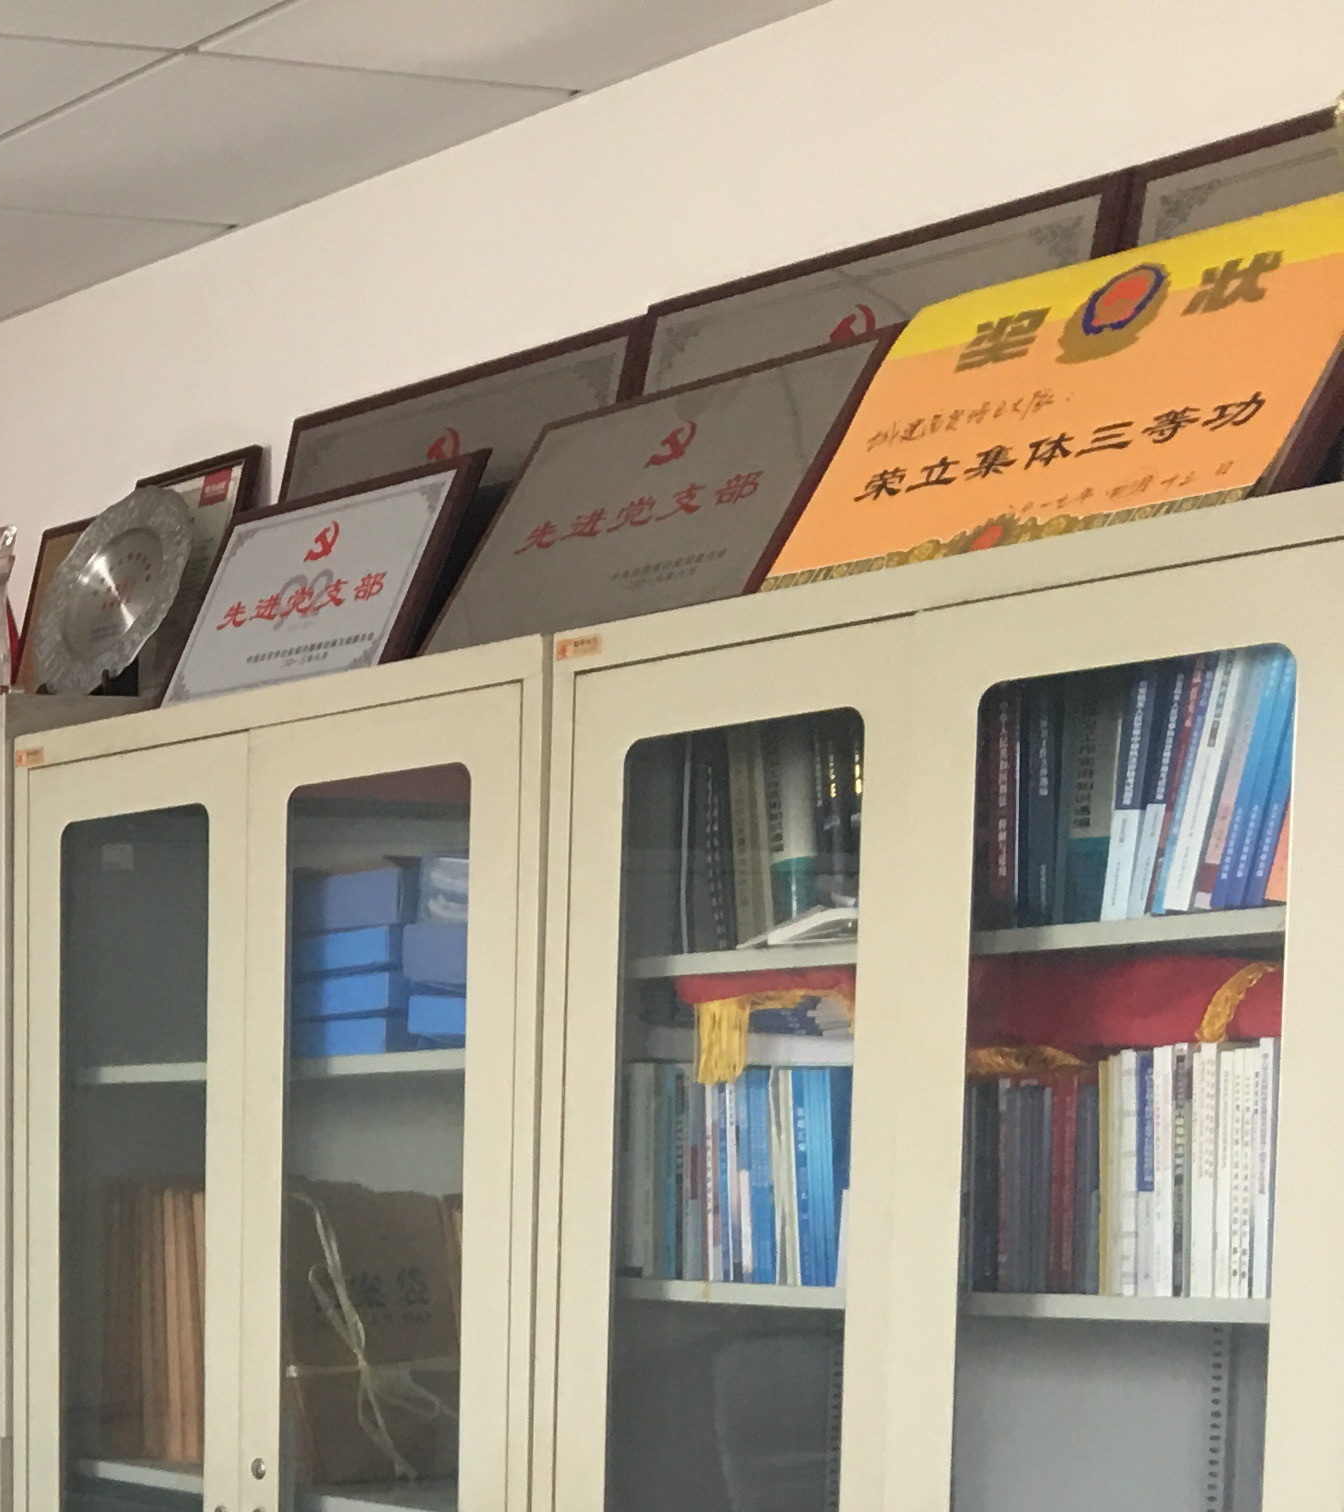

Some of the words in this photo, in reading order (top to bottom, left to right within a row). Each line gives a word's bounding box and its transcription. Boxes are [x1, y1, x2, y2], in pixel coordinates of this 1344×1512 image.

[1180, 250, 1285, 316] 状
[853, 390, 1267, 503] 荣立集体三等功
[514, 469, 765, 556] 先进党支部
[216, 570, 389, 632] 先进党支部
